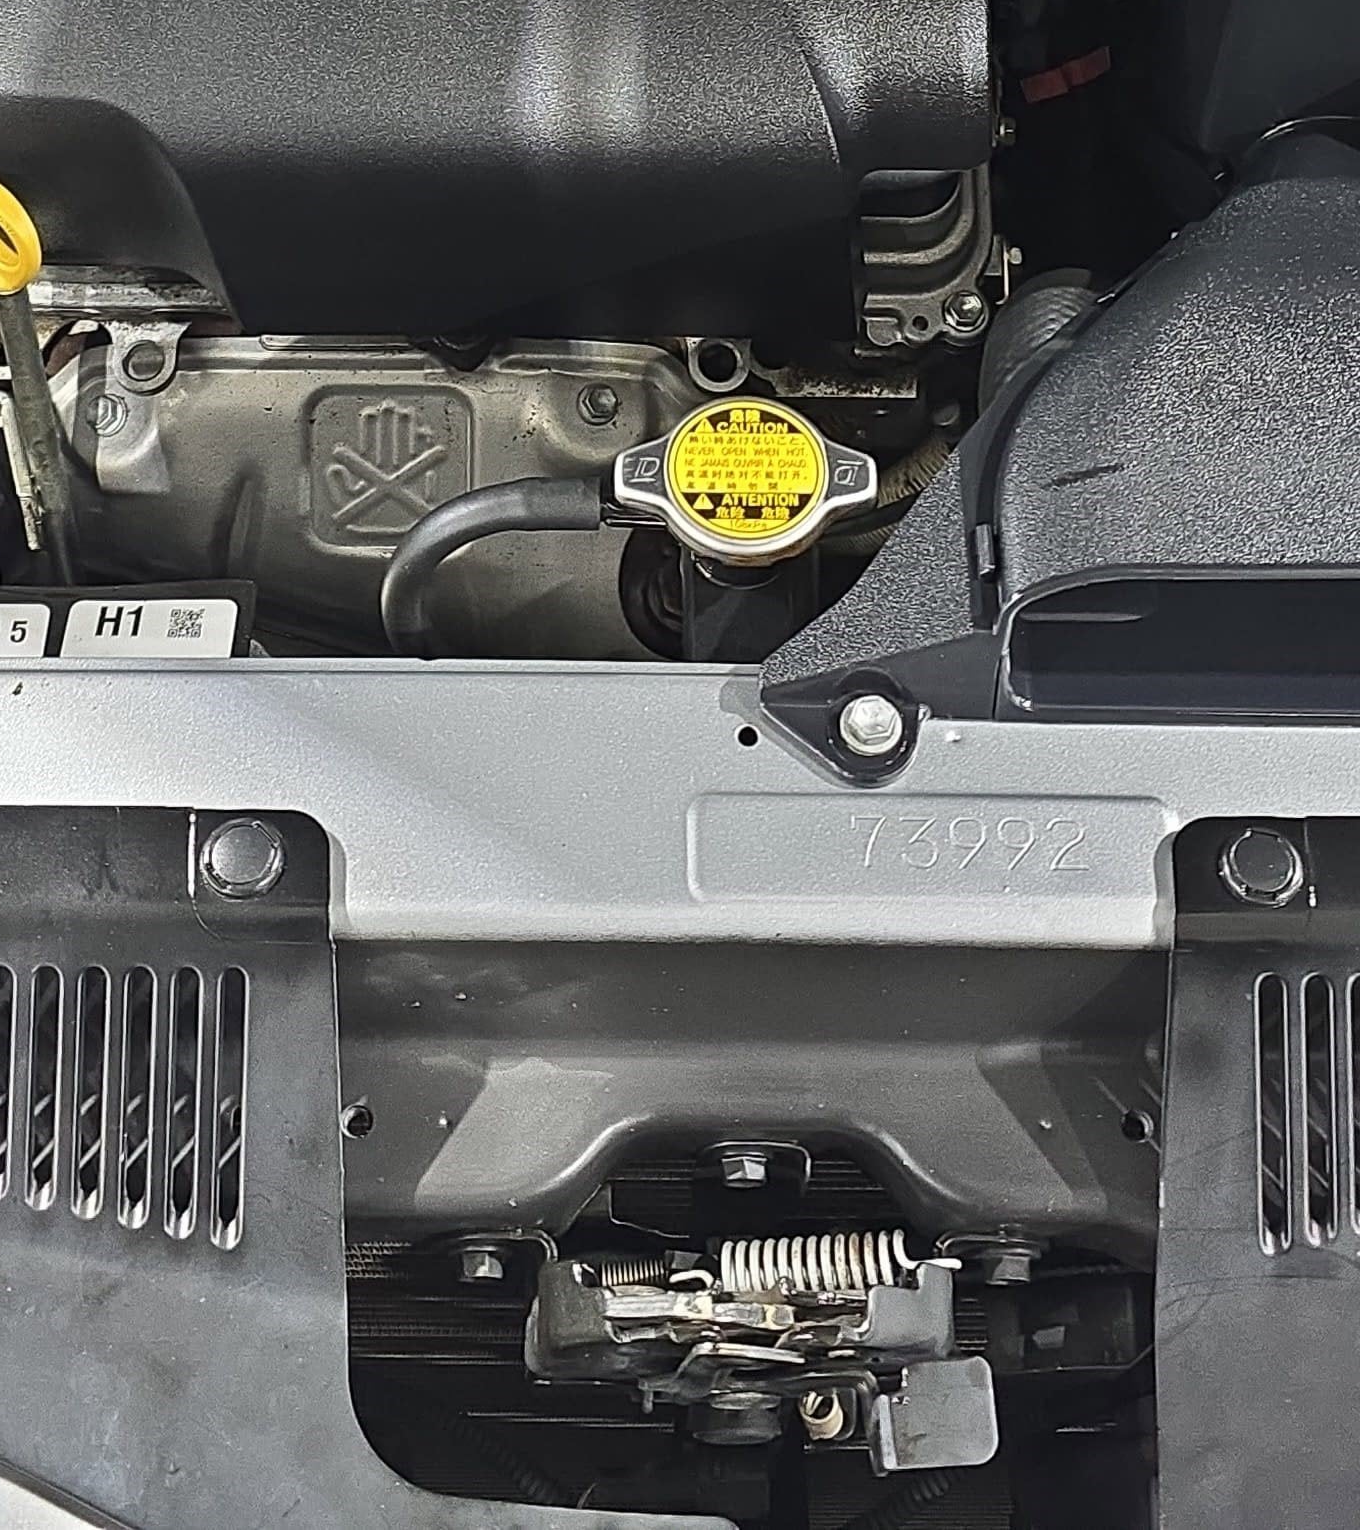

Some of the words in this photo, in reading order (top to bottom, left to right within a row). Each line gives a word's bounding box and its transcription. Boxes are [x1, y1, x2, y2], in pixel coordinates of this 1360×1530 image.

[716, 421, 788, 434] CAUTION
[685, 446, 715, 456] NEVER
[721, 446, 747, 456] OPEN
[754, 446, 779, 456] WHEN
[721, 492, 800, 507] ATTENTION
[10, 620, 28, 643] 5
[95, 606, 144, 638] H1
[849, 814, 1092, 873] 73992
